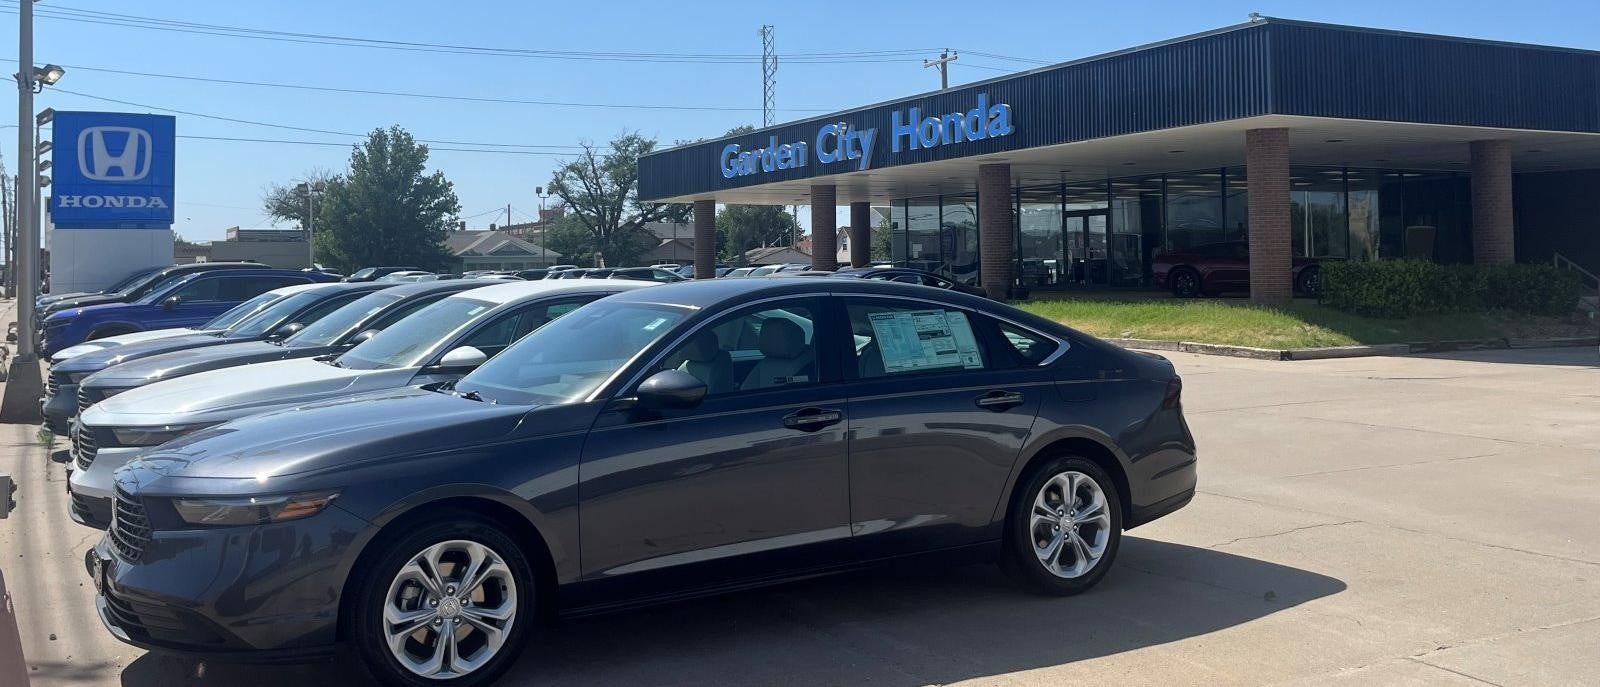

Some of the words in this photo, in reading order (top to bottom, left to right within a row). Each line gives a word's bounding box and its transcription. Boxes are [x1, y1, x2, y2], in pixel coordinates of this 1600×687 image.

[720, 136, 808, 179] Garden
[815, 121, 878, 171] City
[891, 92, 1015, 153] Honda
[59, 195, 168, 208] HONDA
